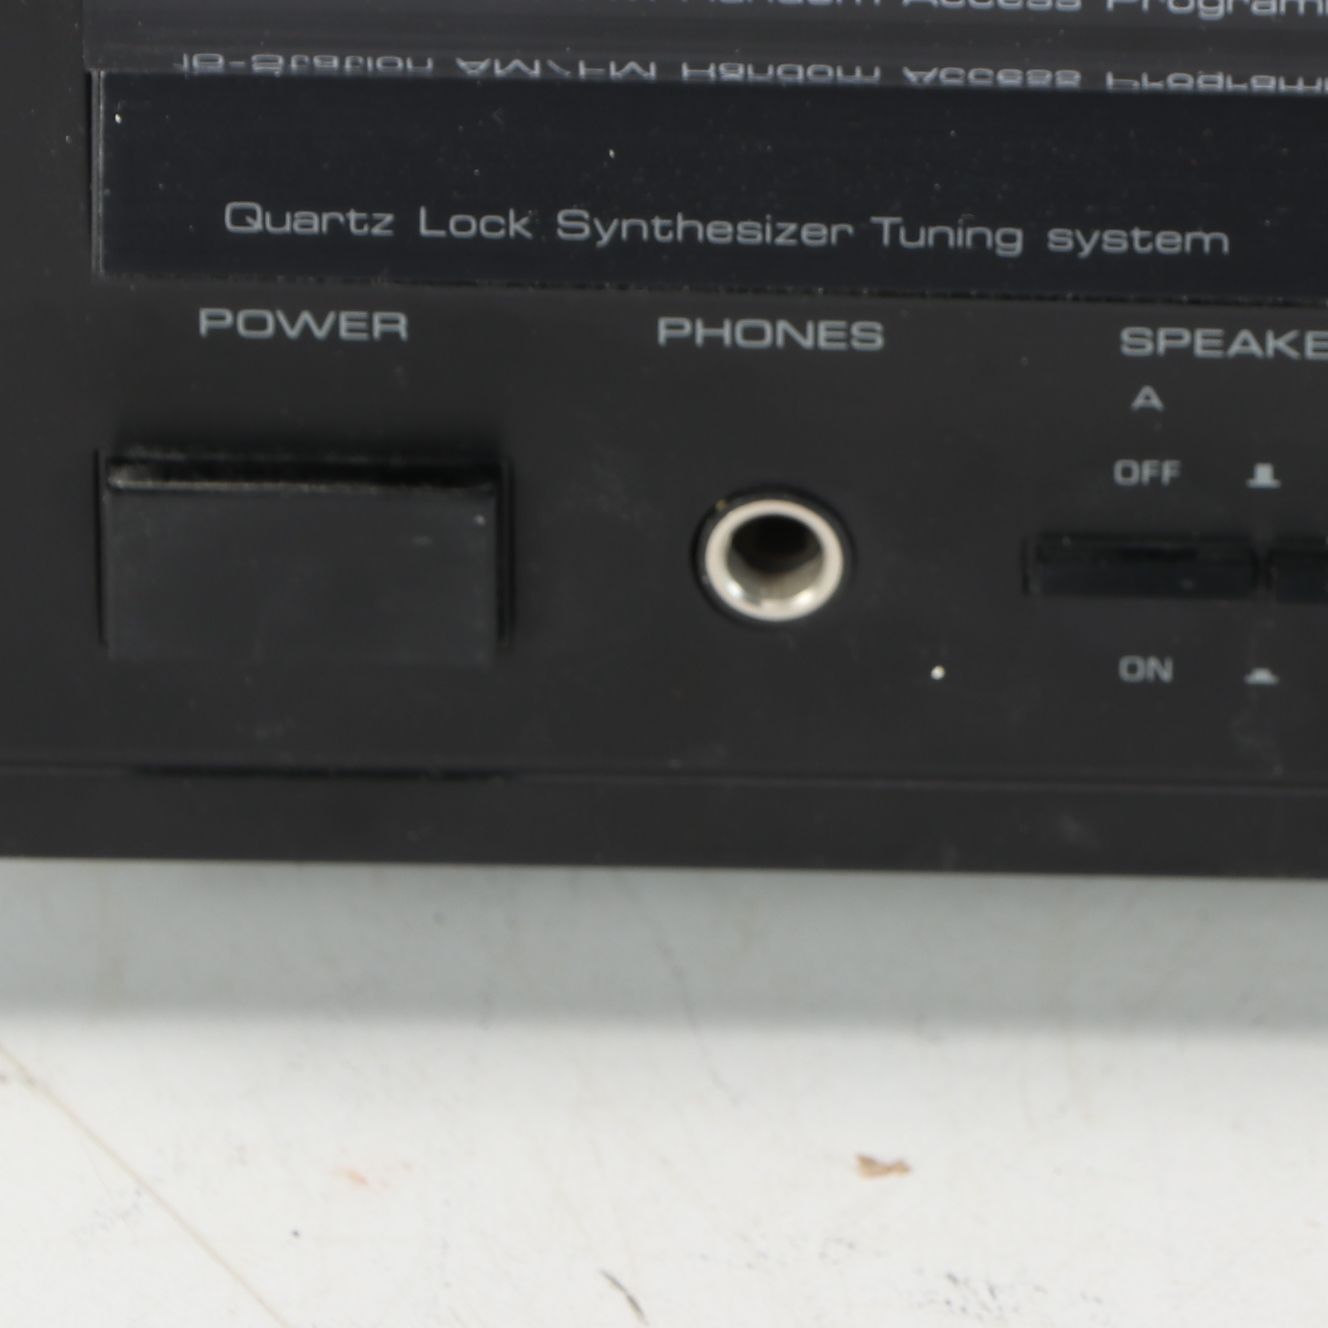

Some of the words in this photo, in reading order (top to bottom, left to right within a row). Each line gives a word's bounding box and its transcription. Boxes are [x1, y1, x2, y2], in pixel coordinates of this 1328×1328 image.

[224, 201, 395, 236] Quartz
[419, 205, 533, 239] Lock
[556, 208, 854, 248] Synthesizer
[870, 216, 1024, 258] Tuning
[1047, 226, 1230, 259] system
[198, 307, 408, 341] POWER
[657, 316, 885, 351] PHONES
[1131, 385, 1164, 411] A
[1113, 459, 1180, 486] OFF
[1118, 655, 1174, 683] ON
